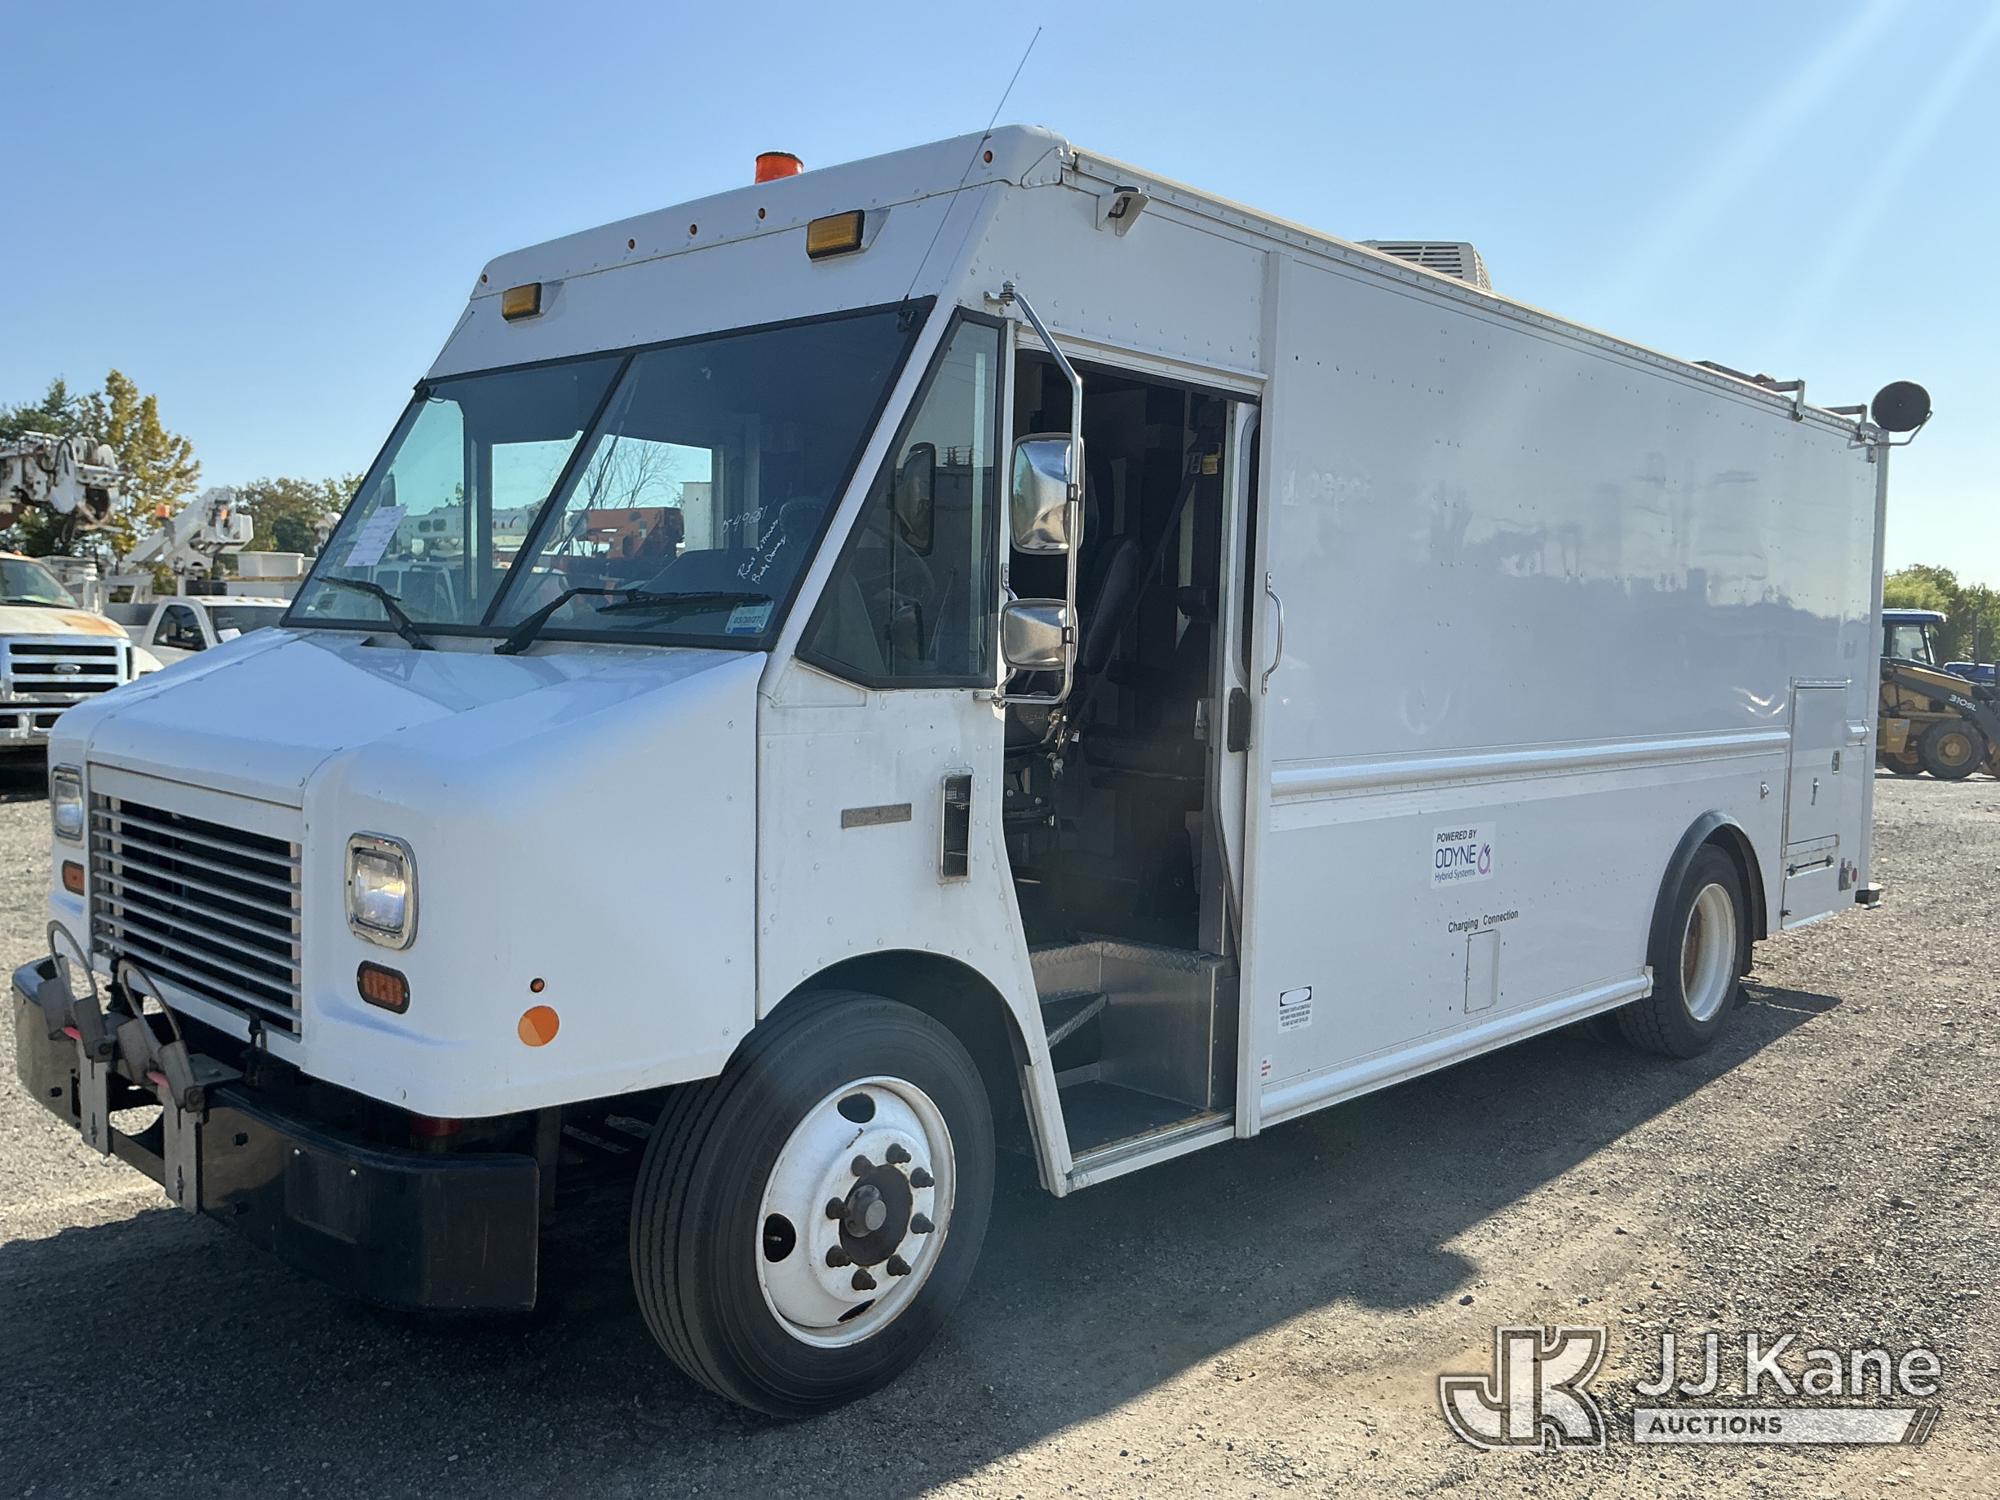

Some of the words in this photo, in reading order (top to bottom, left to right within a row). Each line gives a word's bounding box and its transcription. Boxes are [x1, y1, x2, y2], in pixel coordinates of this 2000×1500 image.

[1436, 830, 1468, 843] POWERED
[1468, 829, 1478, 839] BY
[1435, 844, 1477, 869] ODYNE
[1434, 871, 1453, 883] Hybrid
[1454, 868, 1476, 880] Systems
[1448, 918, 1479, 933] Charging
[1483, 909, 1519, 926] Connection
